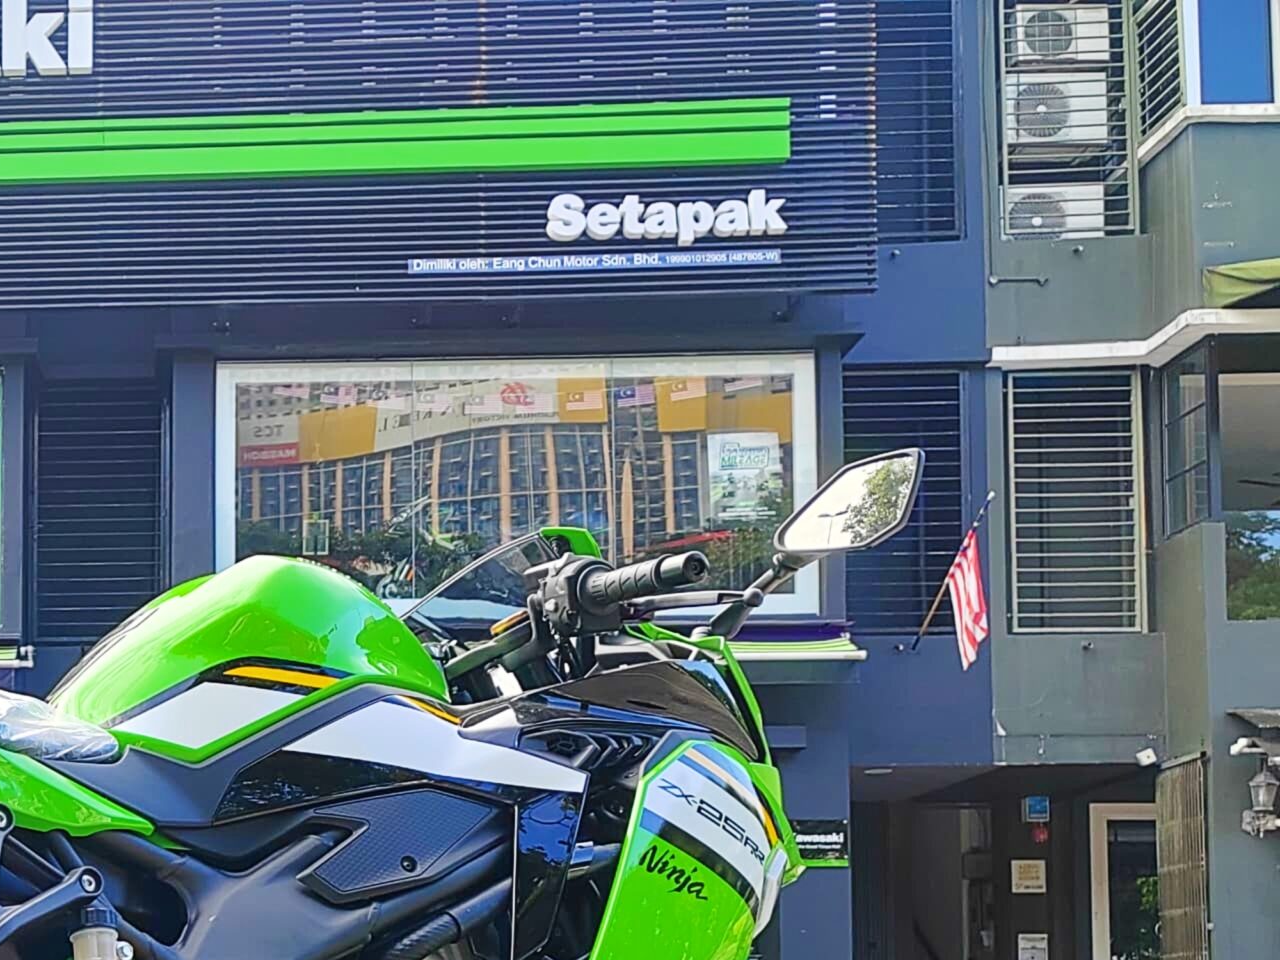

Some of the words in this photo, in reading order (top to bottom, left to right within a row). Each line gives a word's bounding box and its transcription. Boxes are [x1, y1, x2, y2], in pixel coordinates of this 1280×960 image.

[546, 189, 788, 246] Setapak
[413, 258, 457, 270] Dimiliki
[459, 258, 488, 270] oleh:
[493, 257, 524, 271] Eang
[528, 256, 561, 268] Chun
[564, 255, 600, 268] Motor
[602, 254, 629, 266] Sdn.
[634, 253, 661, 265] Bhd.
[793, 832, 844, 843] awasaki
[638, 844, 709, 901] Ninja
